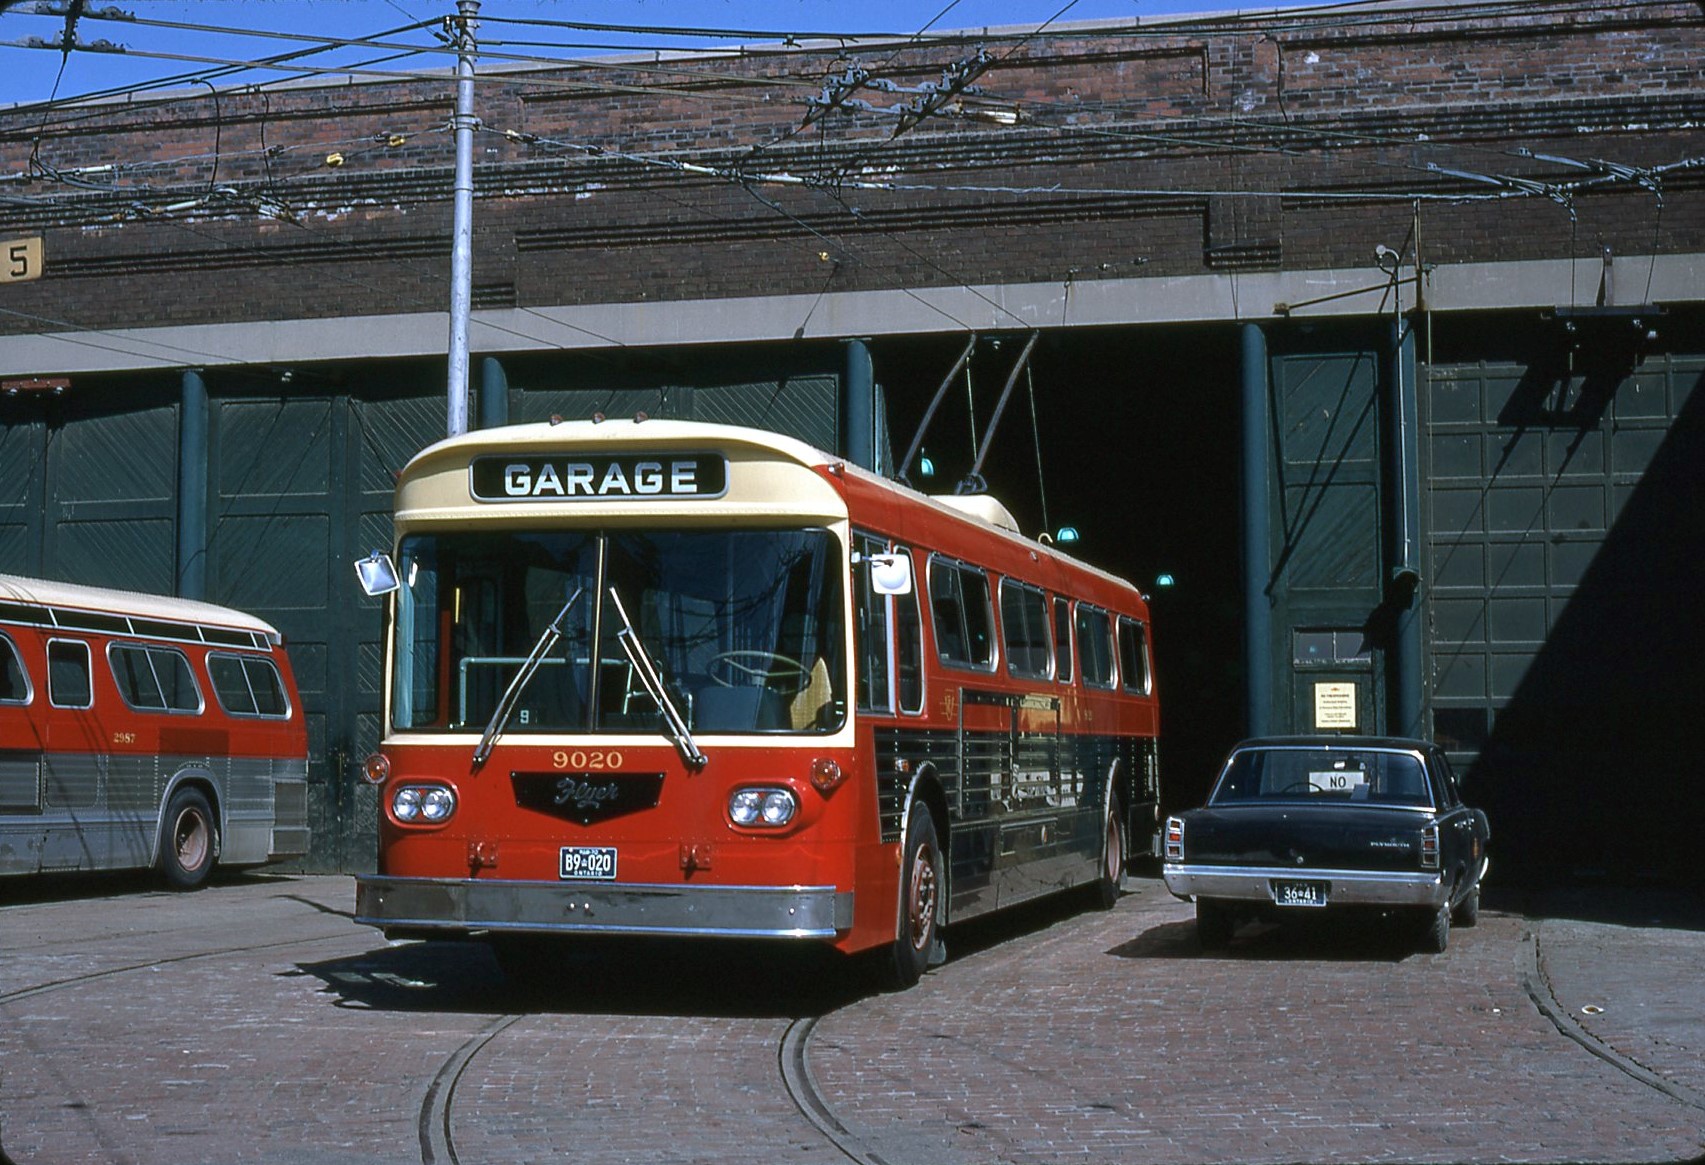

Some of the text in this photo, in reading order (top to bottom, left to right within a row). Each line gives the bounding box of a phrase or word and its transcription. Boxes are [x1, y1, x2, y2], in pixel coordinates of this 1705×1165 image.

[10, 245, 27, 277] 5
[504, 461, 698, 496] GARAGE
[553, 751, 623, 769] 9020
[554, 776, 619, 809] Flyer
[1329, 776, 1347, 788] NO
[574, 869, 603, 877] ONTARIO
